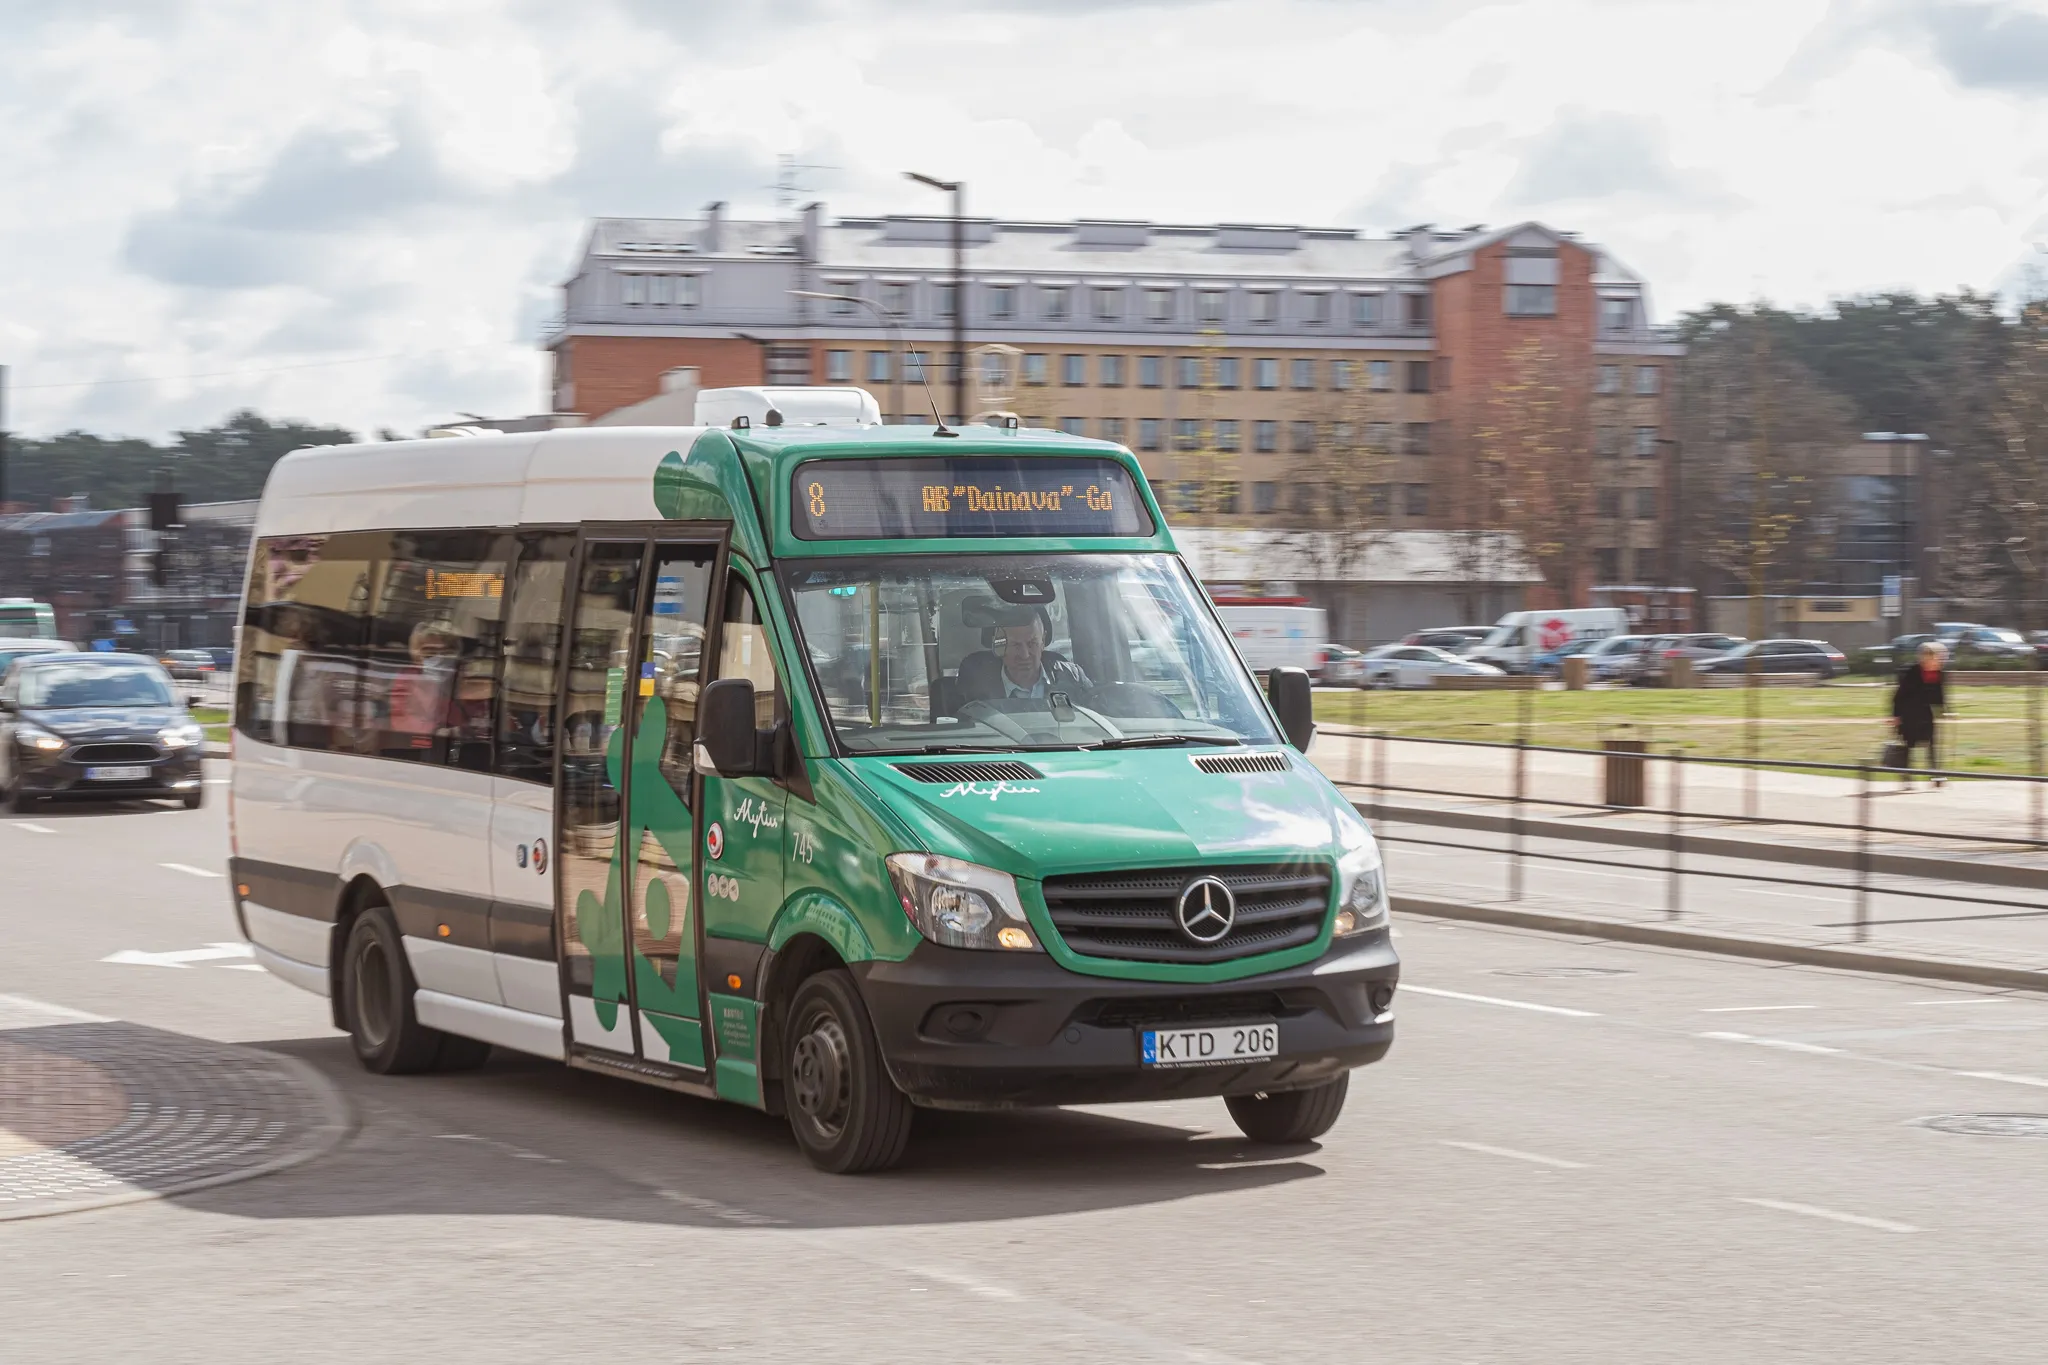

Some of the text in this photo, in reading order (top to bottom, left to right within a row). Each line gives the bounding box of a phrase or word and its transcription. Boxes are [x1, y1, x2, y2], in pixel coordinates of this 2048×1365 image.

[808, 482, 826, 517] 8
[792, 831, 813, 865] 745
[1159, 1028, 1274, 1059] KTD 206
